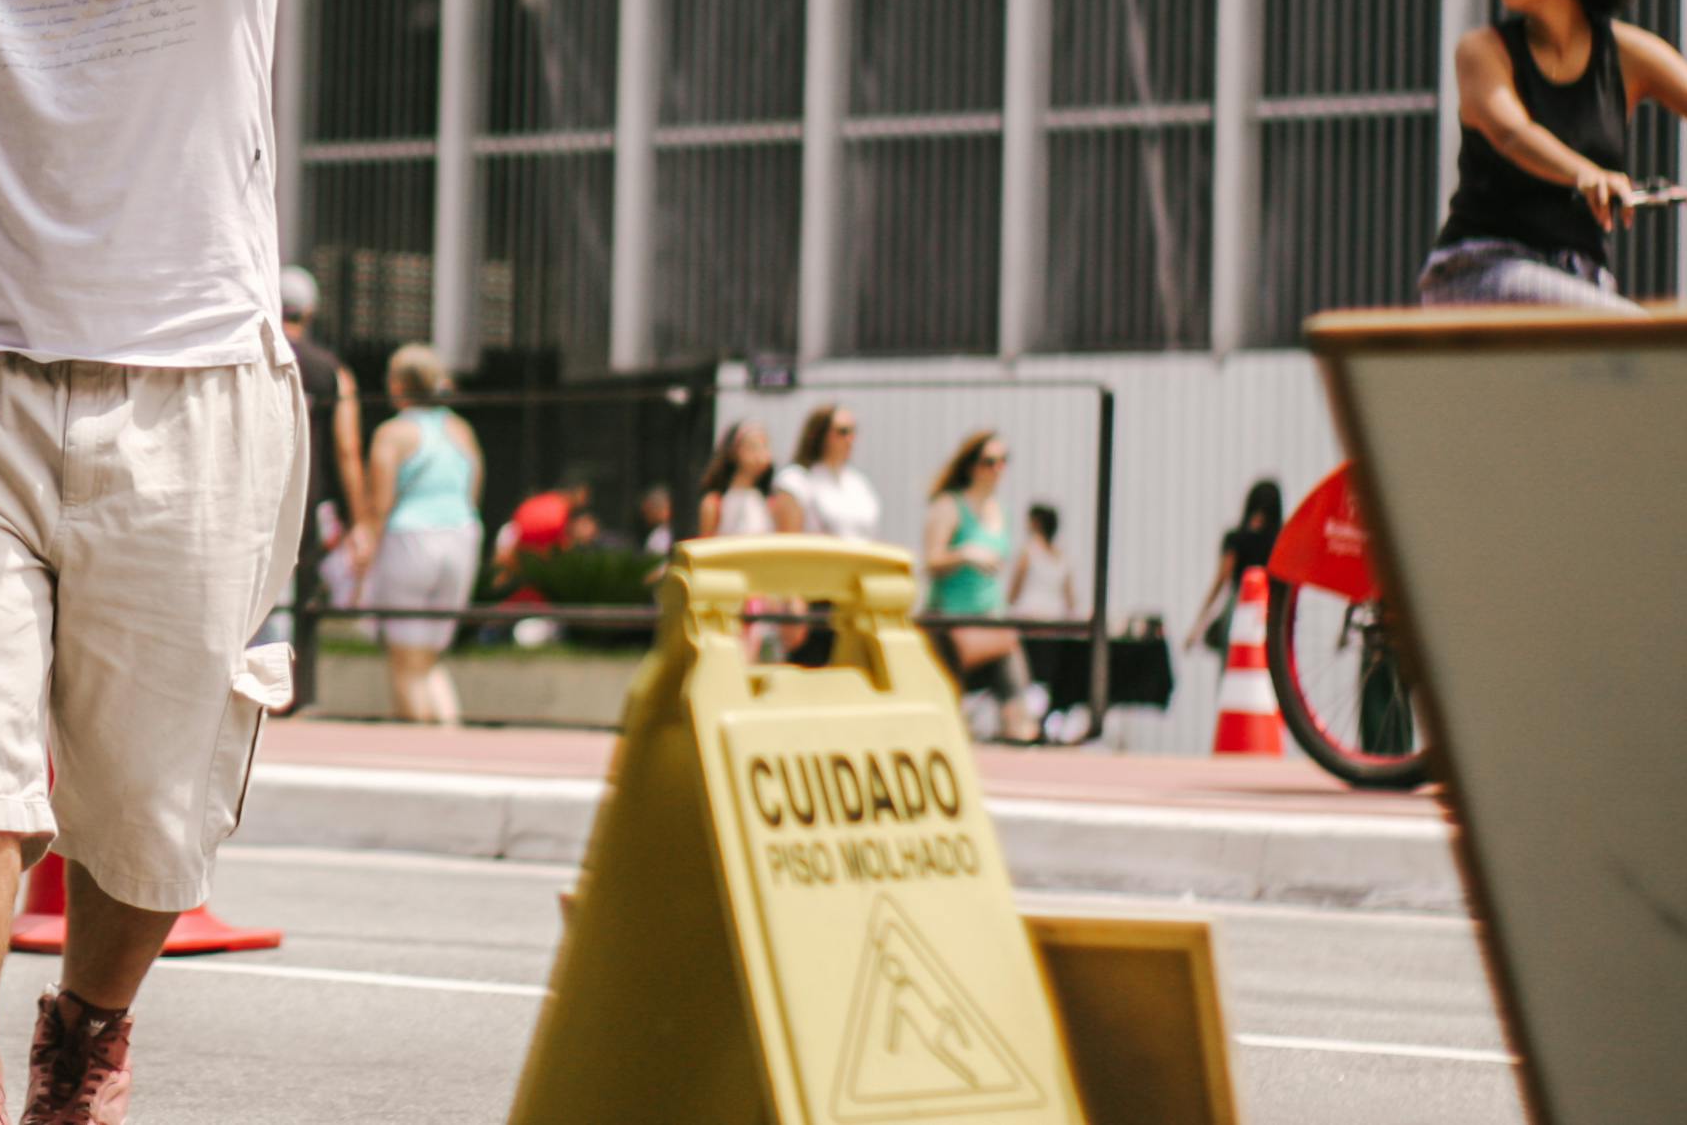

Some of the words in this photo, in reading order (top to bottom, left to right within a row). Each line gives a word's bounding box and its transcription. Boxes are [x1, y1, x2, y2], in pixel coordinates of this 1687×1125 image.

[750, 749, 960, 826] CUIDADO
[767, 842, 836, 885] PISO
[839, 835, 979, 883] MOLHADO
